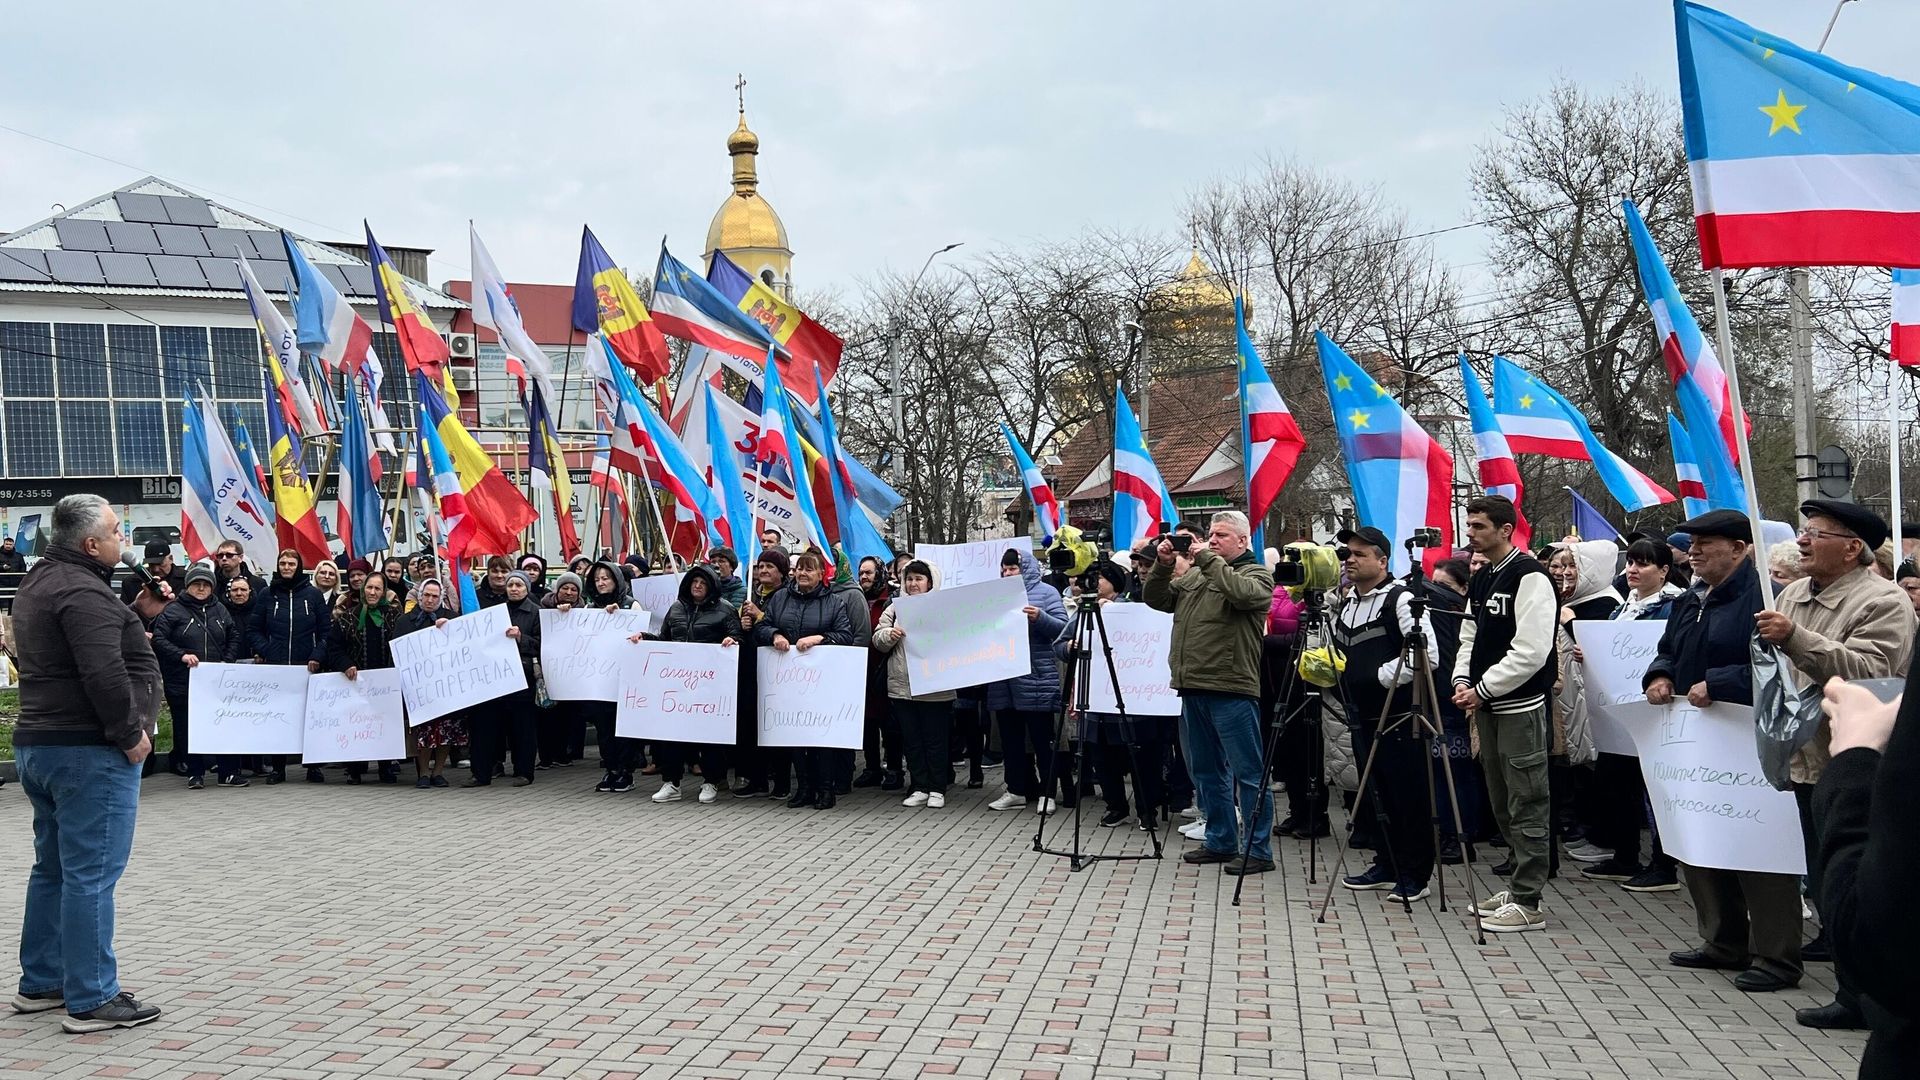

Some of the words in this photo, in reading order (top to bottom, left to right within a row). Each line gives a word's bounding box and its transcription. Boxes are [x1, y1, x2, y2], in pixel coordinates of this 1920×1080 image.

[0, 489, 53, 500] 98/2-35-55
[142, 477, 181, 499] Bilg
[573, 634, 598, 655] ОТ
[401, 646, 473, 687] ПРОТИВ
[217, 669, 280, 697] Гагаузия
[625, 687, 648, 710] Не
